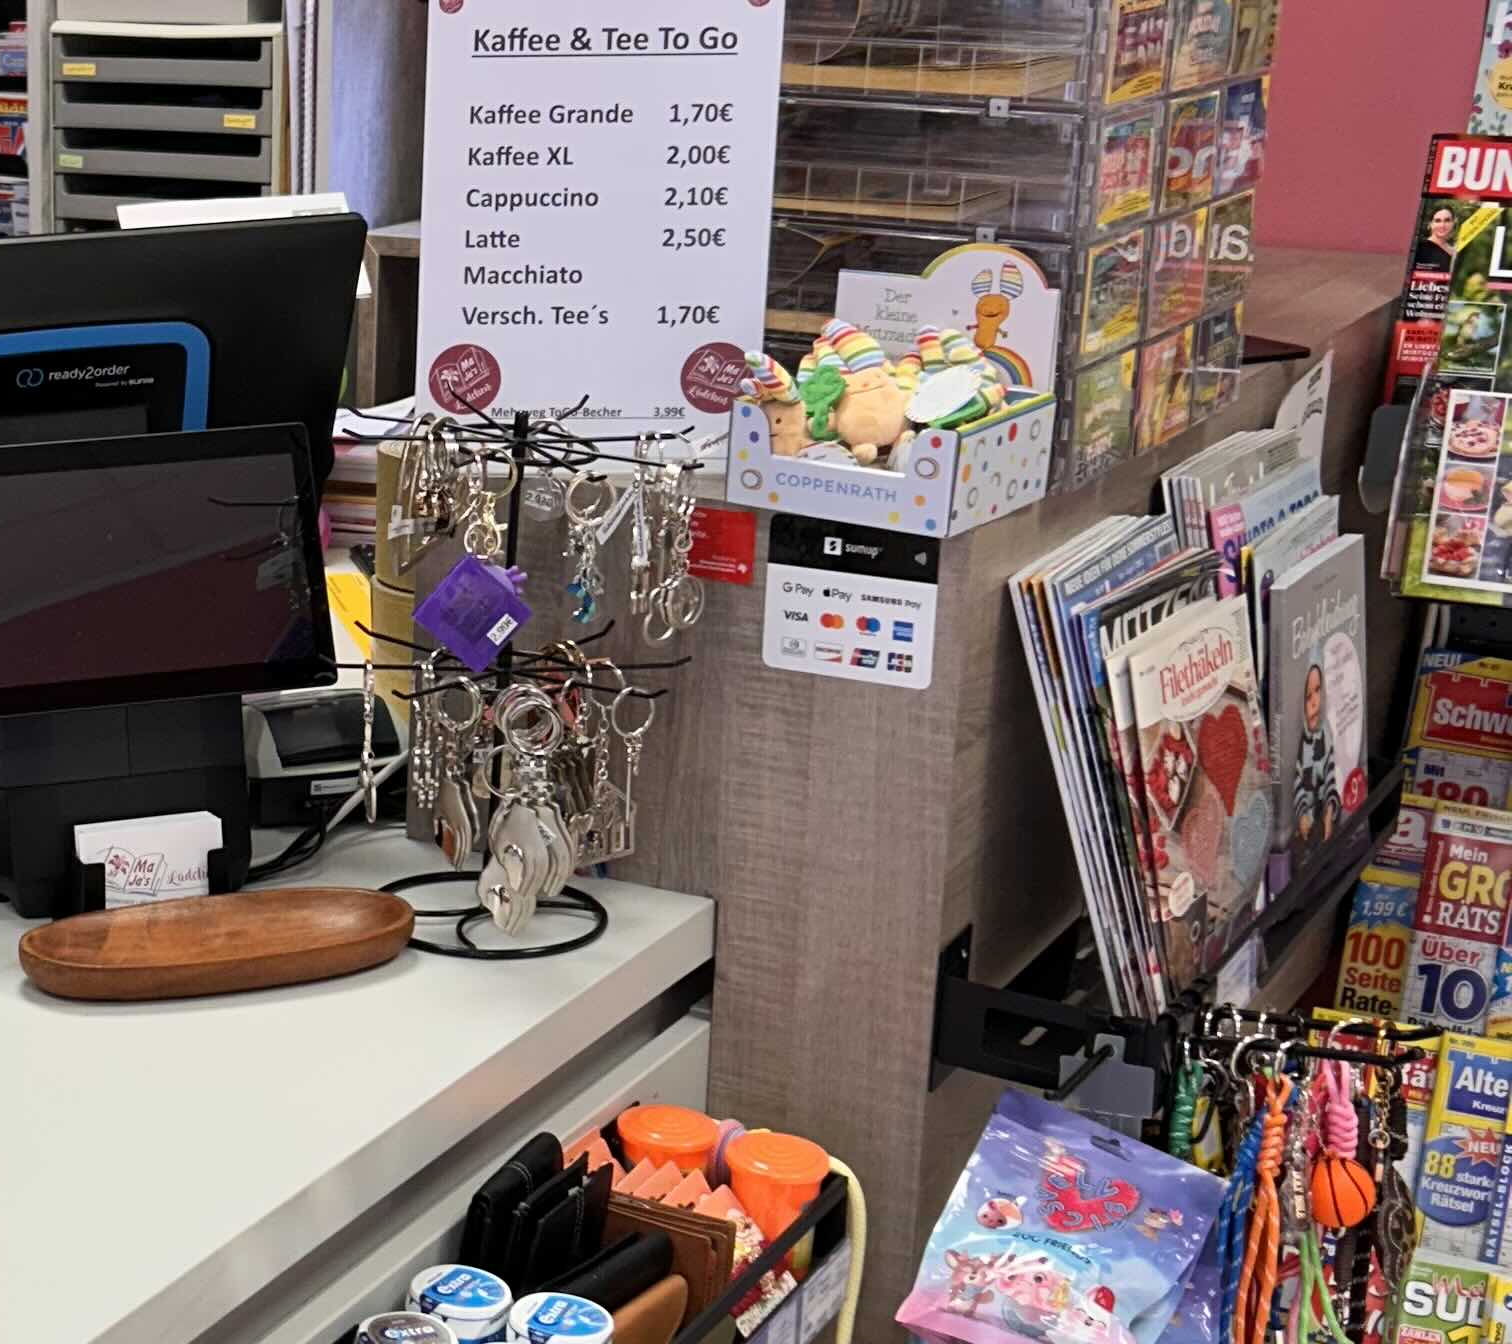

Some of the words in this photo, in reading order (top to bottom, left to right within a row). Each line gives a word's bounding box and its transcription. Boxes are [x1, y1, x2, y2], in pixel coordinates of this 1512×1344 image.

[472, 27, 560, 52] Kaffee
[570, 27, 592, 51] &
[602, 27, 649, 50] Tee
[658, 27, 689, 49] To
[699, 27, 738, 50] Go
[469, 104, 542, 125] Kaffee
[549, 104, 634, 124] Grande
[669, 103, 733, 125] 1,70€
[467, 146, 539, 166] Kaffee
[547, 147, 574, 166] XL
[666, 145, 731, 168] 2,00€
[465, 187, 599, 212] Cappuccino
[664, 187, 729, 210] 2,10€
[465, 229, 520, 249] Latte
[662, 228, 726, 250] 2,50€
[463, 266, 583, 285] Macchiato
[462, 305, 543, 326] Versch.
[656, 305, 720, 326] 1,70€
[48, 365, 130, 380] ready2order
[775, 472, 897, 503] COPPENRATH
[784, 610, 808, 622] VISA
[1423, 654, 1461, 668] NEU!
[1449, 844, 1487, 863] Mein
[1347, 931, 1405, 970] 100
[1421, 935, 1480, 964] Über
[1424, 1150, 1455, 1180] 88
[1430, 1193, 1475, 1215] Rätsel
[385, 1324, 435, 1338] extra
